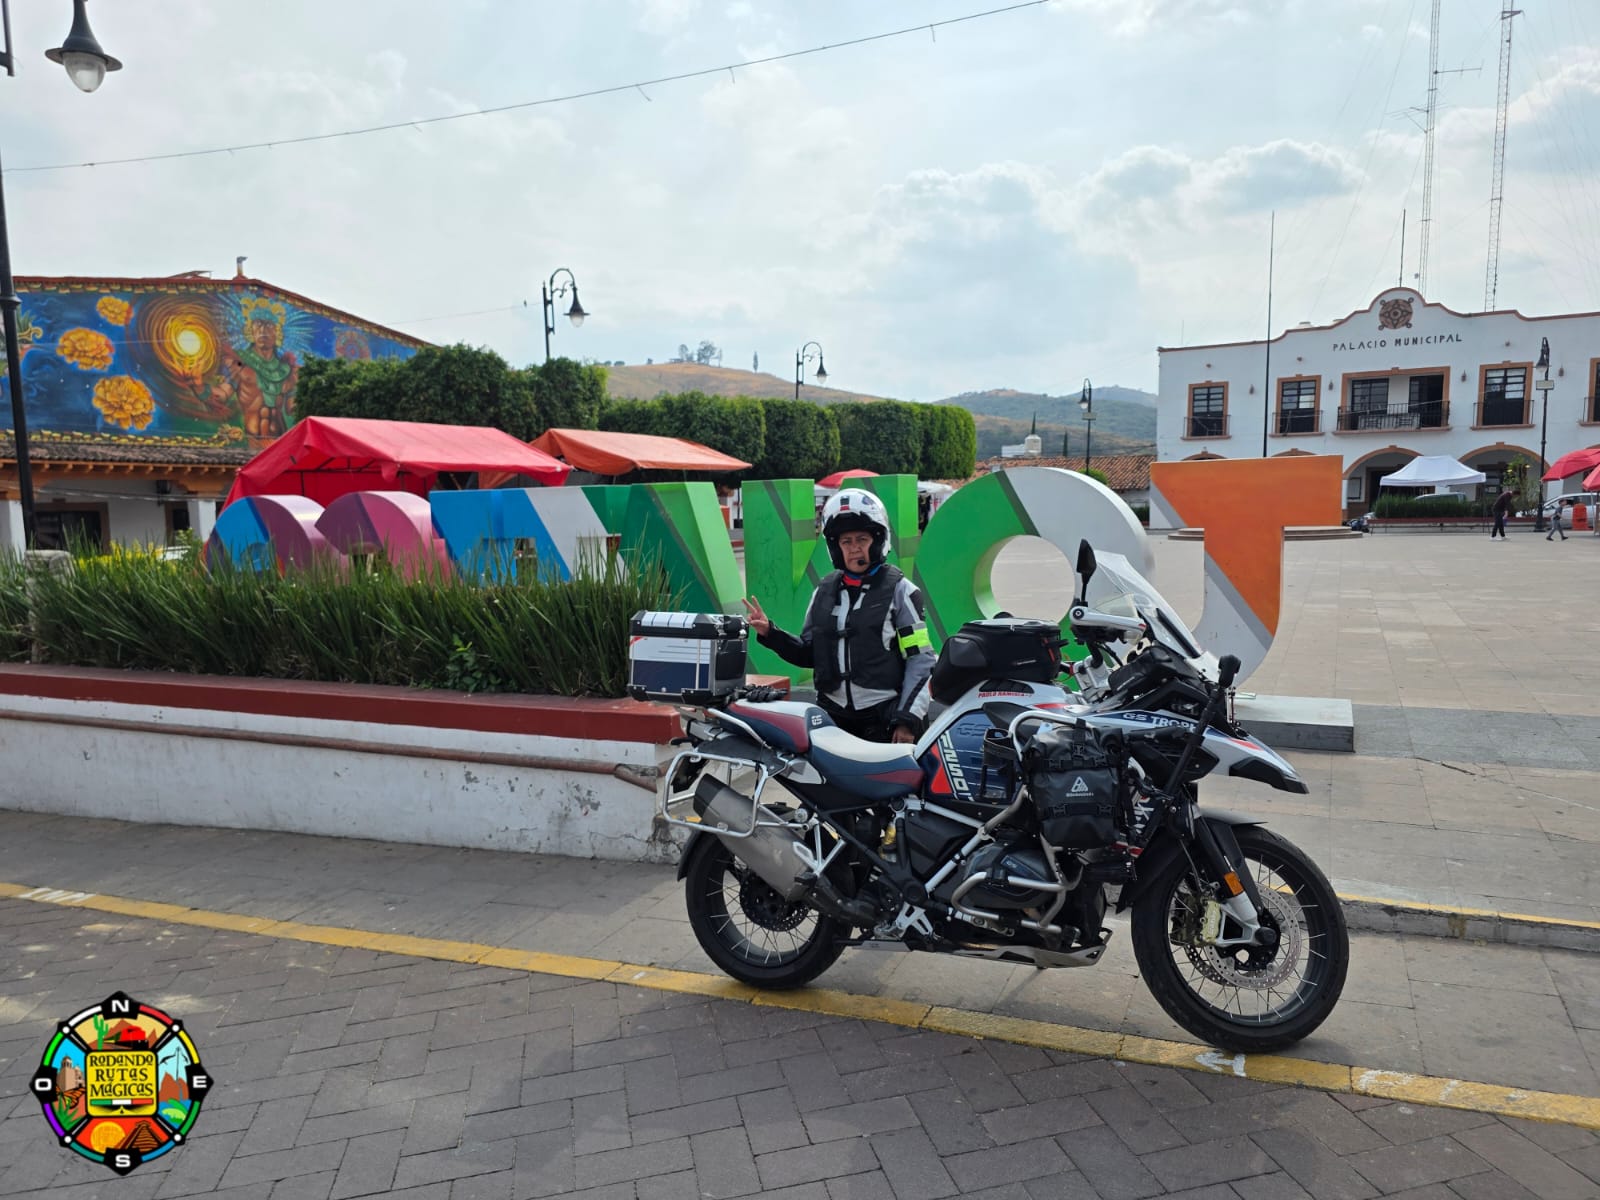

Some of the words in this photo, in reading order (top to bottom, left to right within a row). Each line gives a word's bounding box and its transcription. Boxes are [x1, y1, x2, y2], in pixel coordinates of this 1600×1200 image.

[1332, 339, 1387, 351] PALACIO
[1394, 333, 1463, 347] MUNICIPAL
[1122, 712, 1148, 721] GS
[1150, 716, 1197, 734] TROPH
